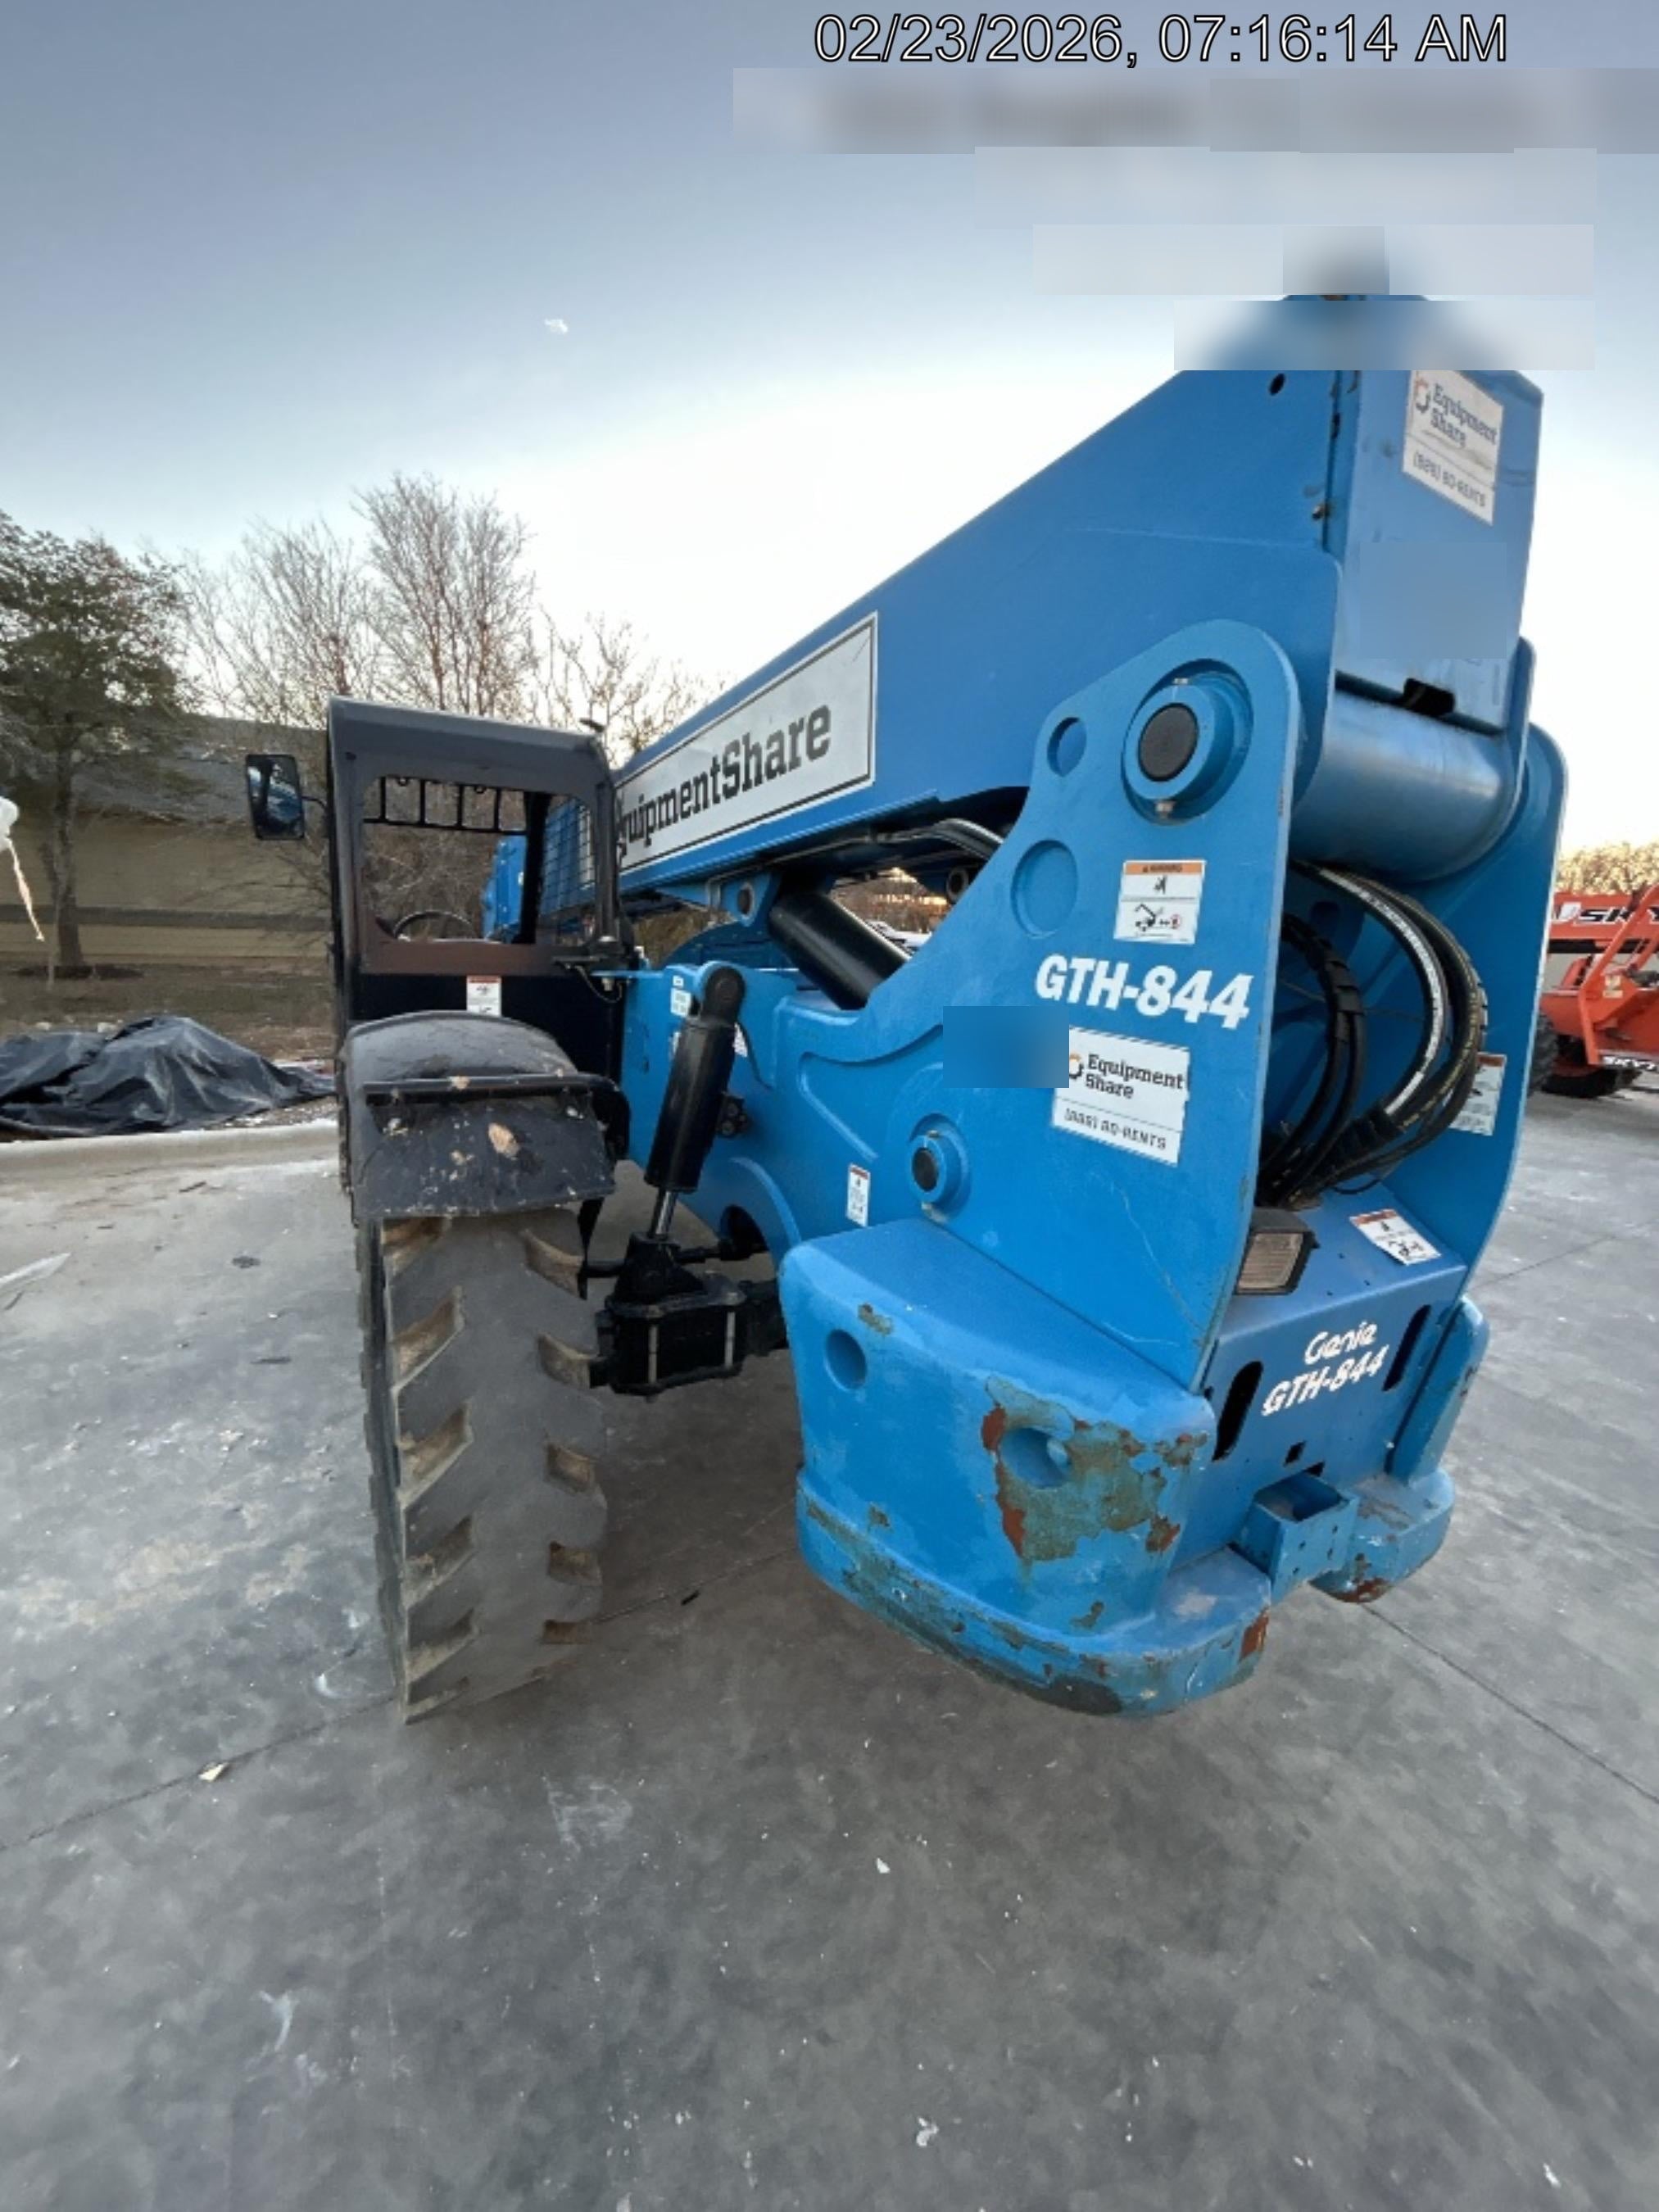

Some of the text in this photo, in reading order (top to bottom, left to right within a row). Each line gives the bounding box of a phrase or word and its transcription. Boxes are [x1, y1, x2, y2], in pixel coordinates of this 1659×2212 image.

[1430, 408, 1466, 448] Share
[1433, 383, 1498, 445] Equipment
[616, 704, 832, 859] quipmentShare
[1035, 954, 1253, 1030] GTH-844
[1086, 1074, 1135, 1099] Share
[1088, 1054, 1185, 1090] Equipment
[1304, 1321, 1377, 1365] Genie
[1262, 1344, 1389, 1416] GTH-844
